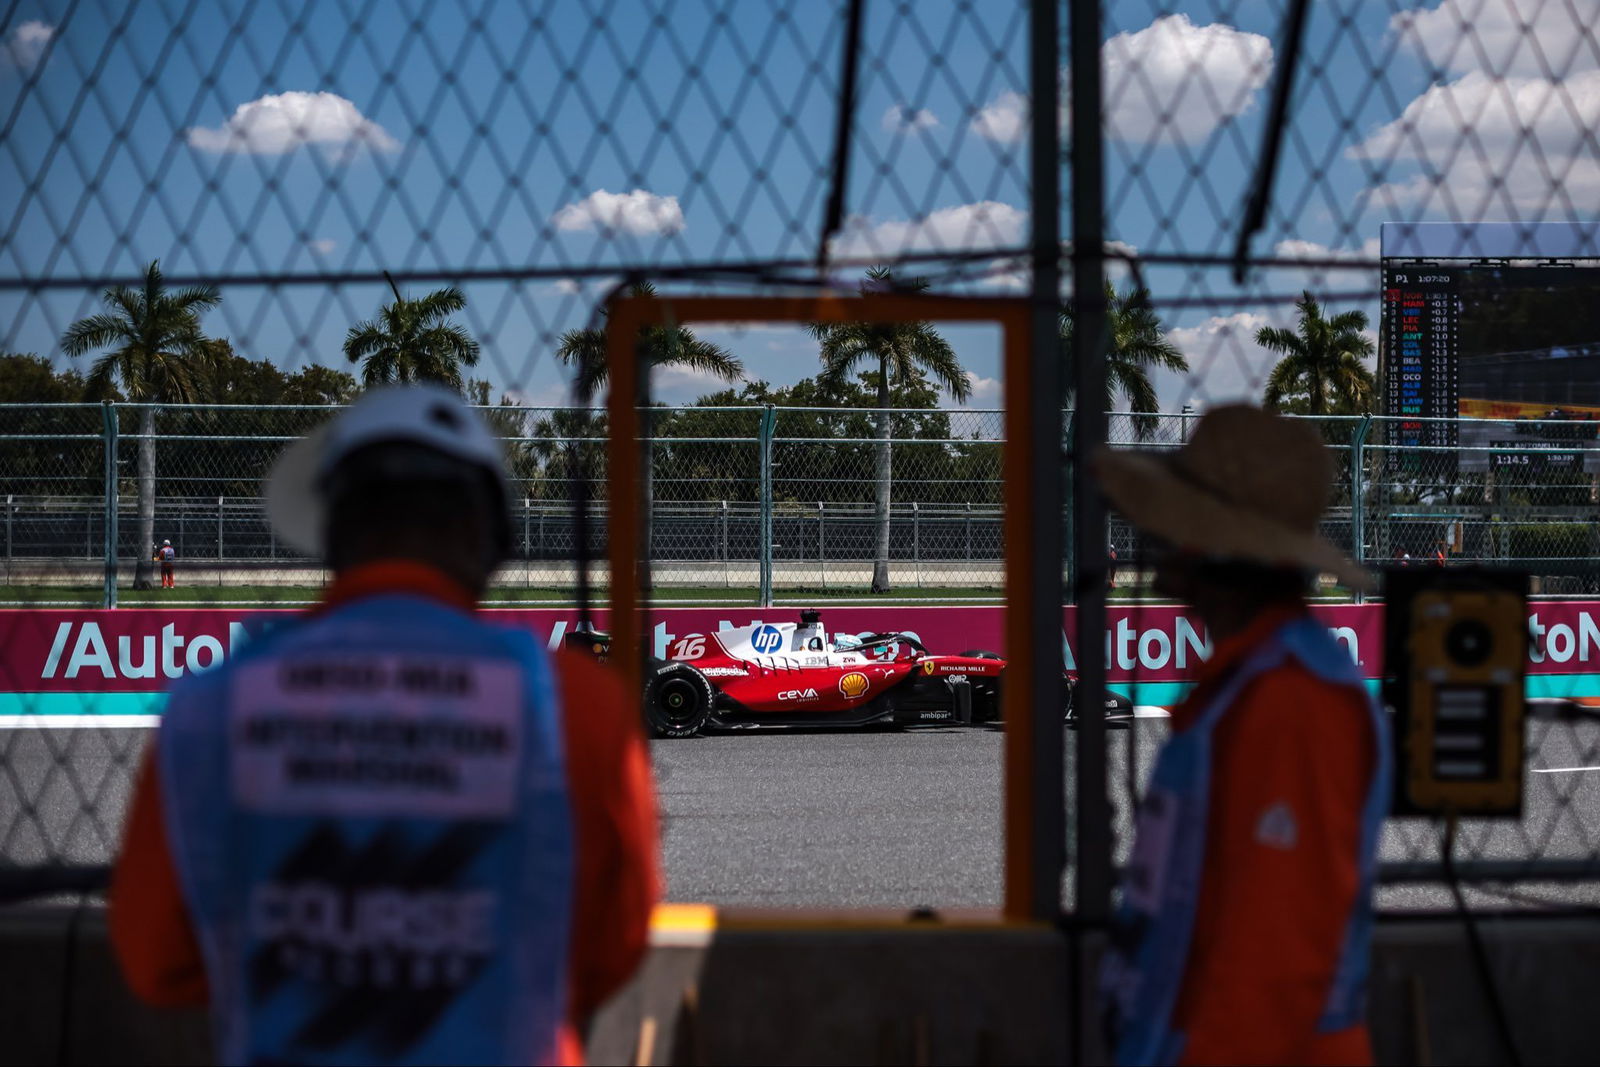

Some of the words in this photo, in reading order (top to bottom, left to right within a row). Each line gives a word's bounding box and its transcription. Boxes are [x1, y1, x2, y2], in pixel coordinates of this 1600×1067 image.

[1395, 274, 1408, 283] P1
[1496, 455, 1529, 465] 1:14.5
[754, 625, 780, 655] hp
[671, 637, 706, 661] 16
[804, 656, 828, 666] IBM
[920, 711, 948, 719] ambipar
